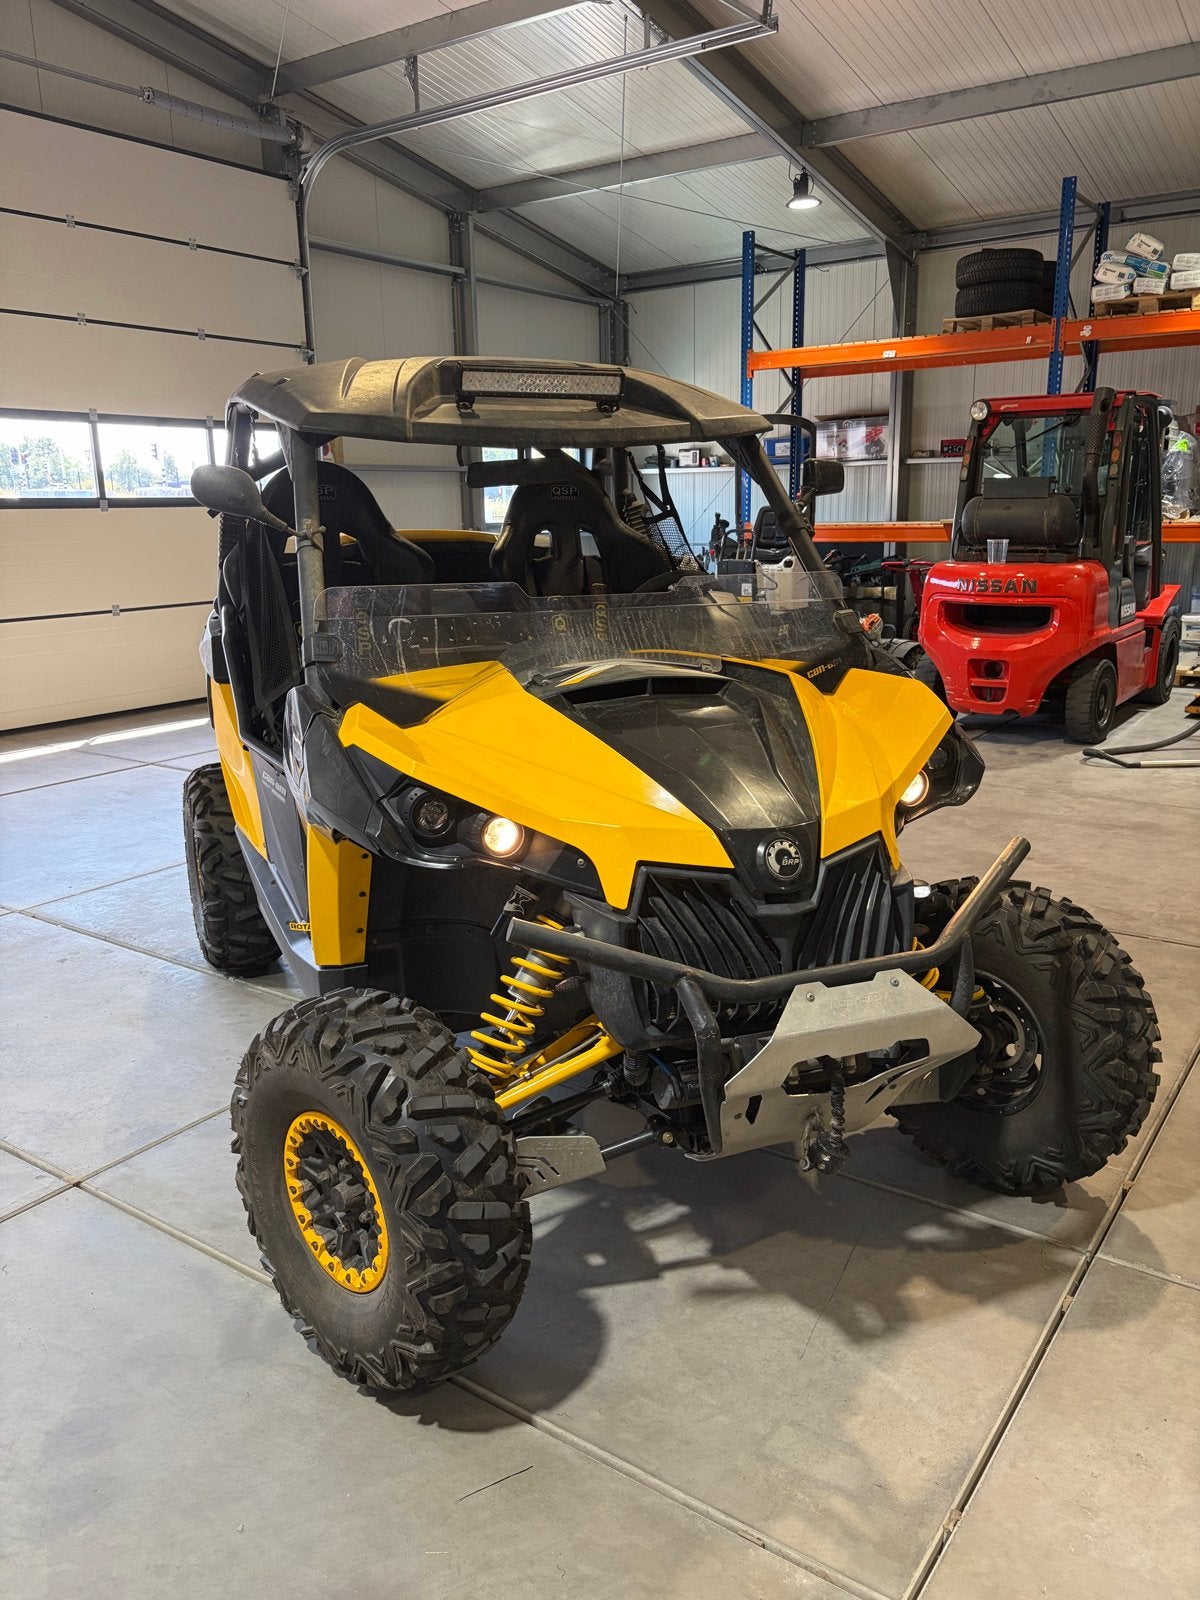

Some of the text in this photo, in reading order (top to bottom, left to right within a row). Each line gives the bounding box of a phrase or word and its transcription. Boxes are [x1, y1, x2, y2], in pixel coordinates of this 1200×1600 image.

[317, 486, 334, 495] SP
[552, 486, 577, 496] QSP
[958, 578, 1037, 593] NISSAN
[262, 770, 287, 797] can-am
[782, 858, 800, 866] BRP
